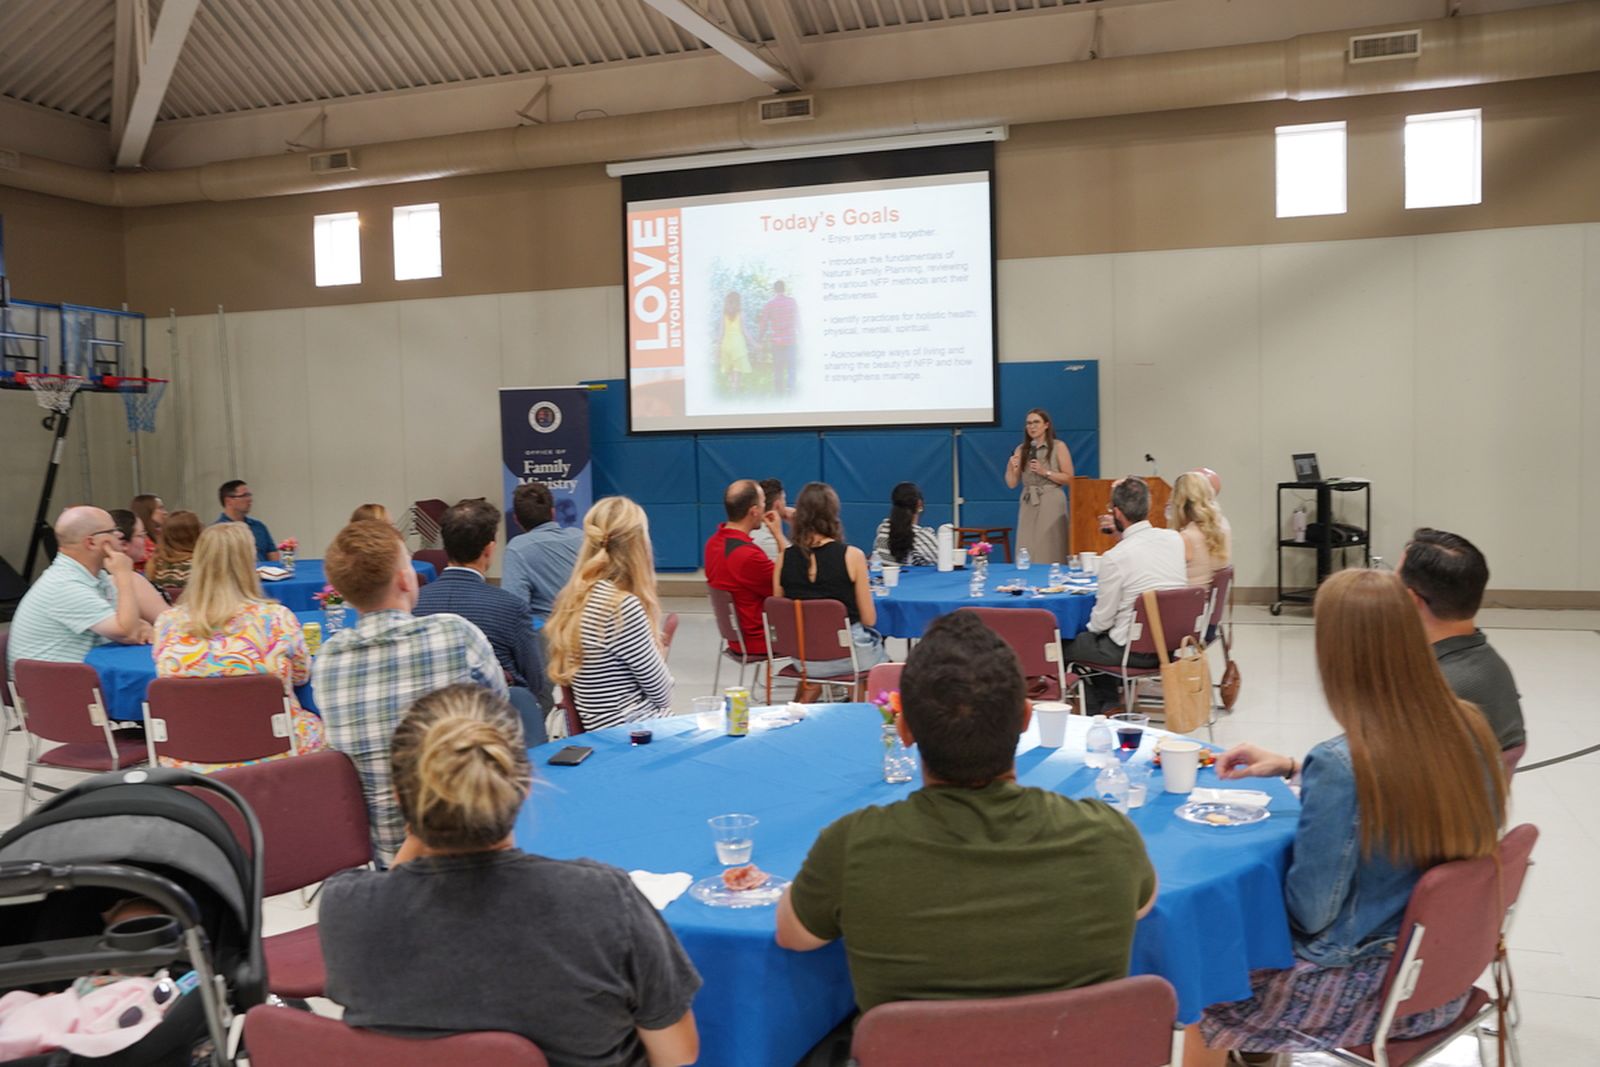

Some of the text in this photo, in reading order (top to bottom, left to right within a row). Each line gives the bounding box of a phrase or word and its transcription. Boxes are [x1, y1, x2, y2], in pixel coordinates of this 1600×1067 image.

[760, 206, 900, 233] Today’s Goals
[828, 234, 851, 244] Enjoy
[885, 252, 943, 262] fundamentals
[945, 250, 954, 259] of
[855, 267, 881, 276] Family
[927, 262, 969, 272] reviewing
[632, 217, 668, 350] LOVE
[667, 216, 681, 348] BEYOND MEASURE
[838, 280, 867, 288] various
[871, 277, 889, 286] NFP
[891, 276, 928, 285] methods
[950, 274, 969, 282] their
[861, 313, 899, 323] practices
[902, 312, 914, 320] for
[916, 311, 946, 319] holistic
[830, 346, 965, 358] Acknowledge ways of living and
[824, 361, 855, 371] sharing
[872, 360, 900, 370] beauty
[903, 359, 912, 367] of
[914, 358, 933, 367] NFP
[936, 358, 952, 366] and
[832, 373, 881, 383] strengthens
[523, 459, 571, 477] Family
